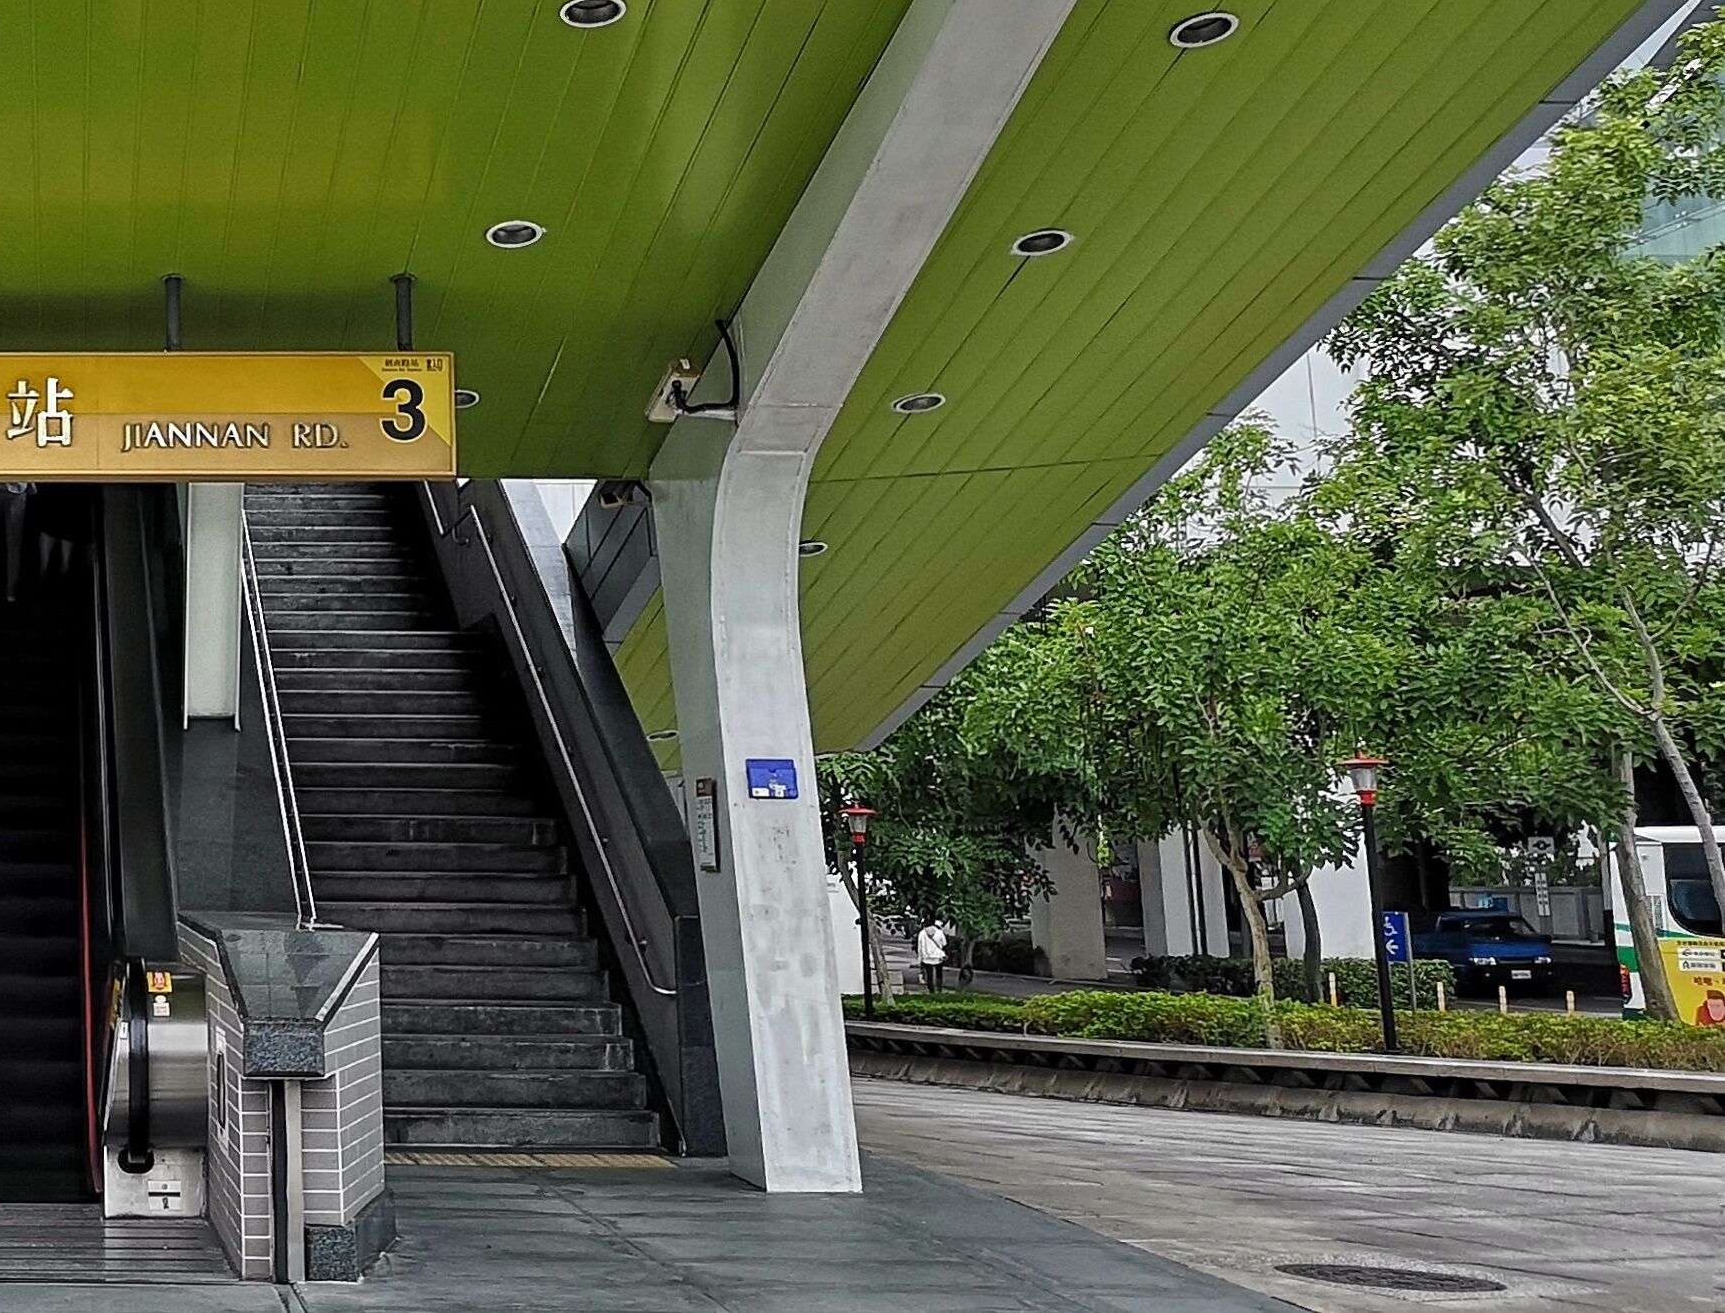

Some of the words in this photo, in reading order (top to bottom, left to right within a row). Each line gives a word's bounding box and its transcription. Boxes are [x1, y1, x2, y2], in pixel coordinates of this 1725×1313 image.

[380, 378, 427, 442] 3
[121, 422, 270, 453] JIANNAN
[292, 422, 349, 449] RD.
